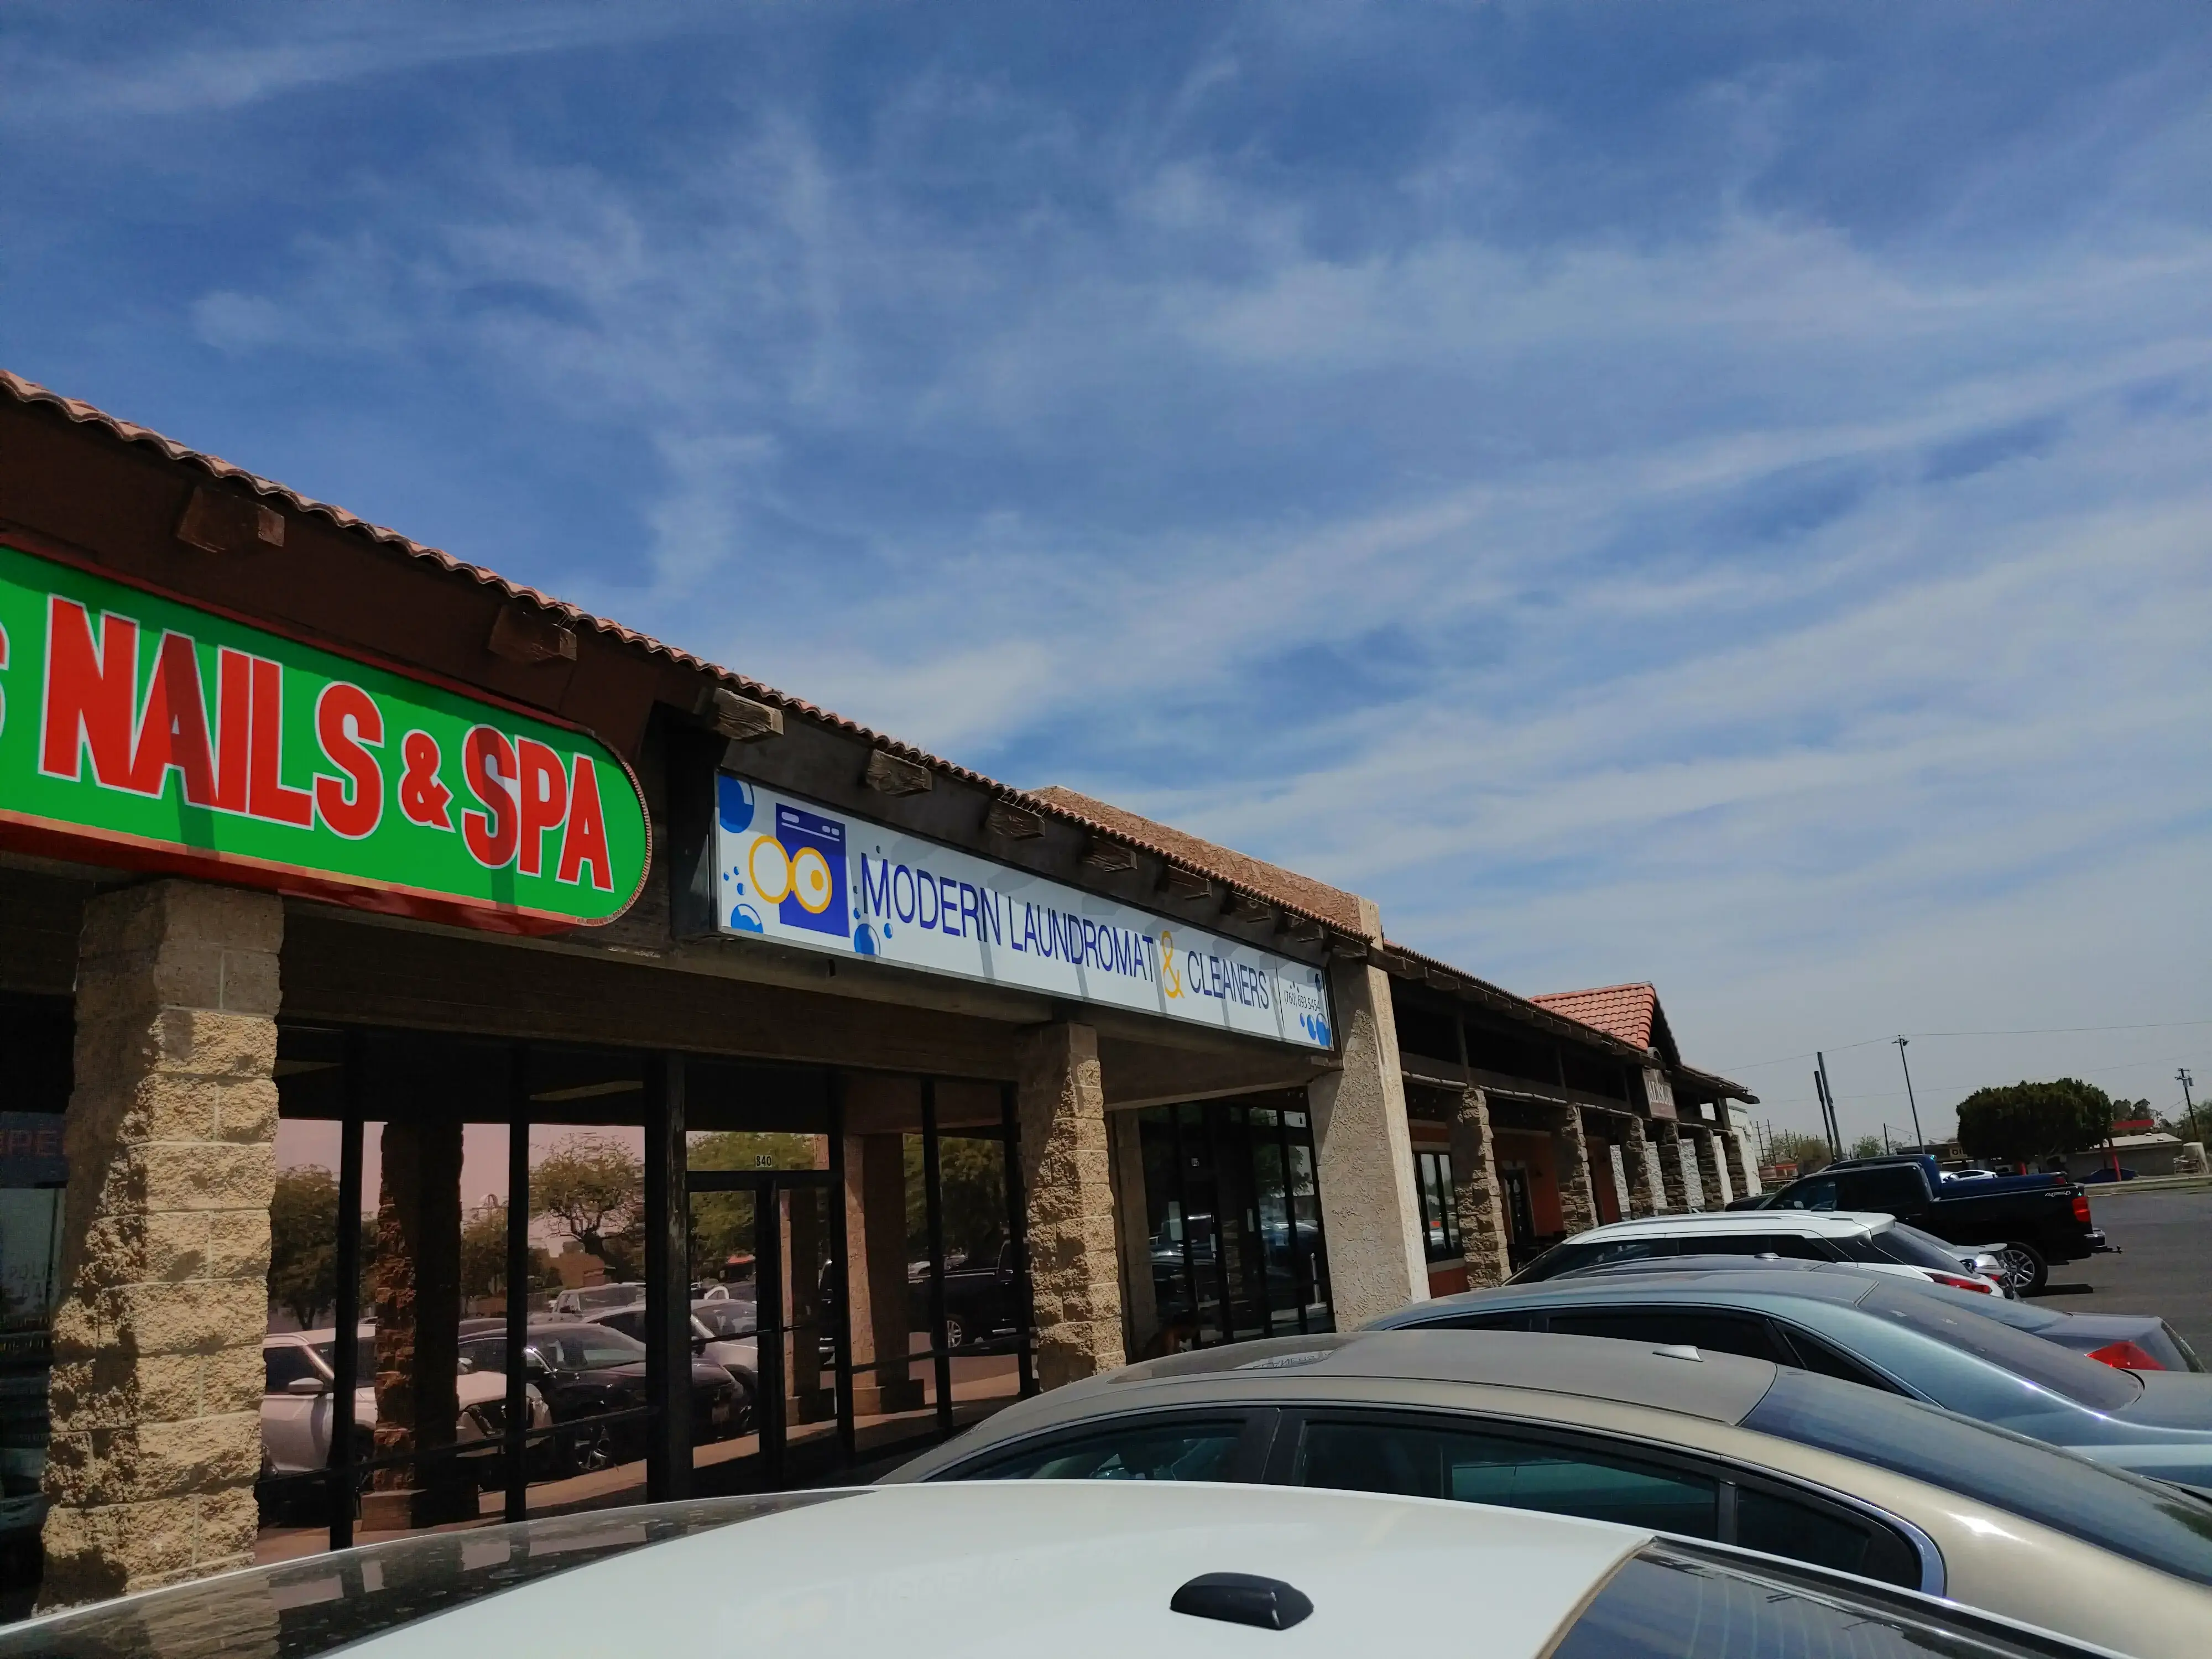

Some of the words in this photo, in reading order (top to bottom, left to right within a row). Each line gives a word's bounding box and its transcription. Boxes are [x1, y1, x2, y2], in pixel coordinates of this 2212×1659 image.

[38, 594, 385, 840] NAILS
[398, 729, 455, 833] &
[461, 723, 614, 893] SPA
[860, 853, 1001, 946] MODERN
[1008, 896, 1155, 982] LAUNDROMAT
[1161, 931, 1185, 999] &
[1187, 951, 1270, 1010] CLEANERS
[1284, 989, 1297, 1006] (760)
[1298, 994, 1307, 1009] 693
[1308, 998, 1321, 1012] 5454
[756, 1155, 771, 1167] 840
